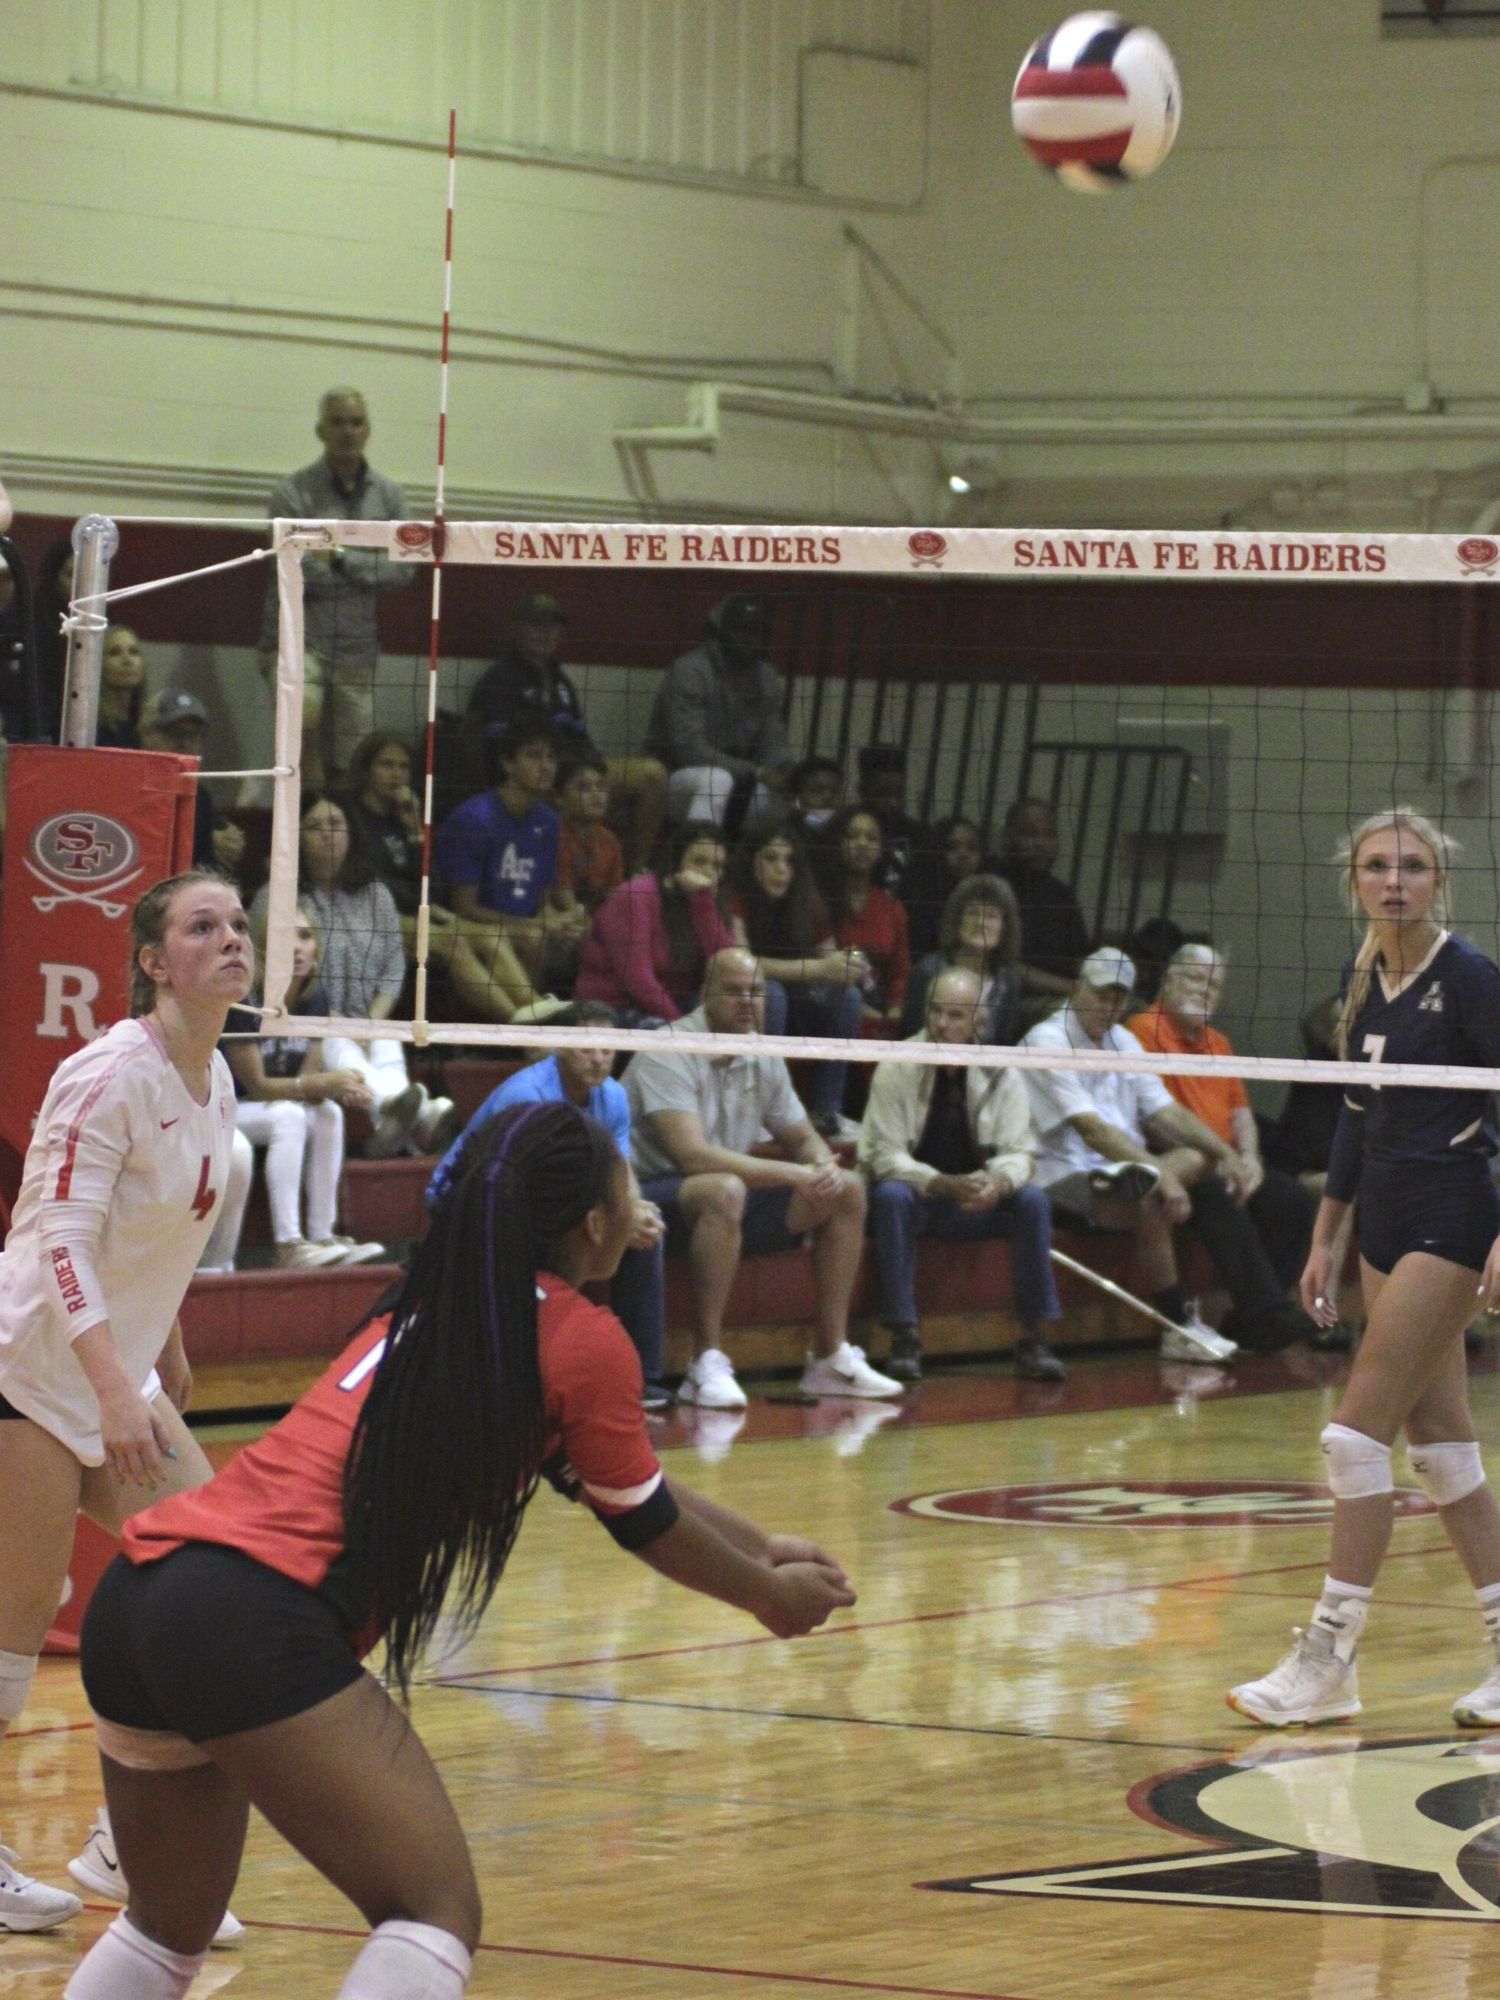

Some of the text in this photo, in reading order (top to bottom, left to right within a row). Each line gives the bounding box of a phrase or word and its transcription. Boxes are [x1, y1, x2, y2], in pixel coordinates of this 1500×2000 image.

[494, 531, 841, 564] SANTA FE RAIDERS
[1013, 539, 1387, 573] SANTA FE RAIDERS
[56, 820, 114, 873] SF
[190, 1154, 216, 1221] 4
[51, 1246, 87, 1315] RAIDERS
